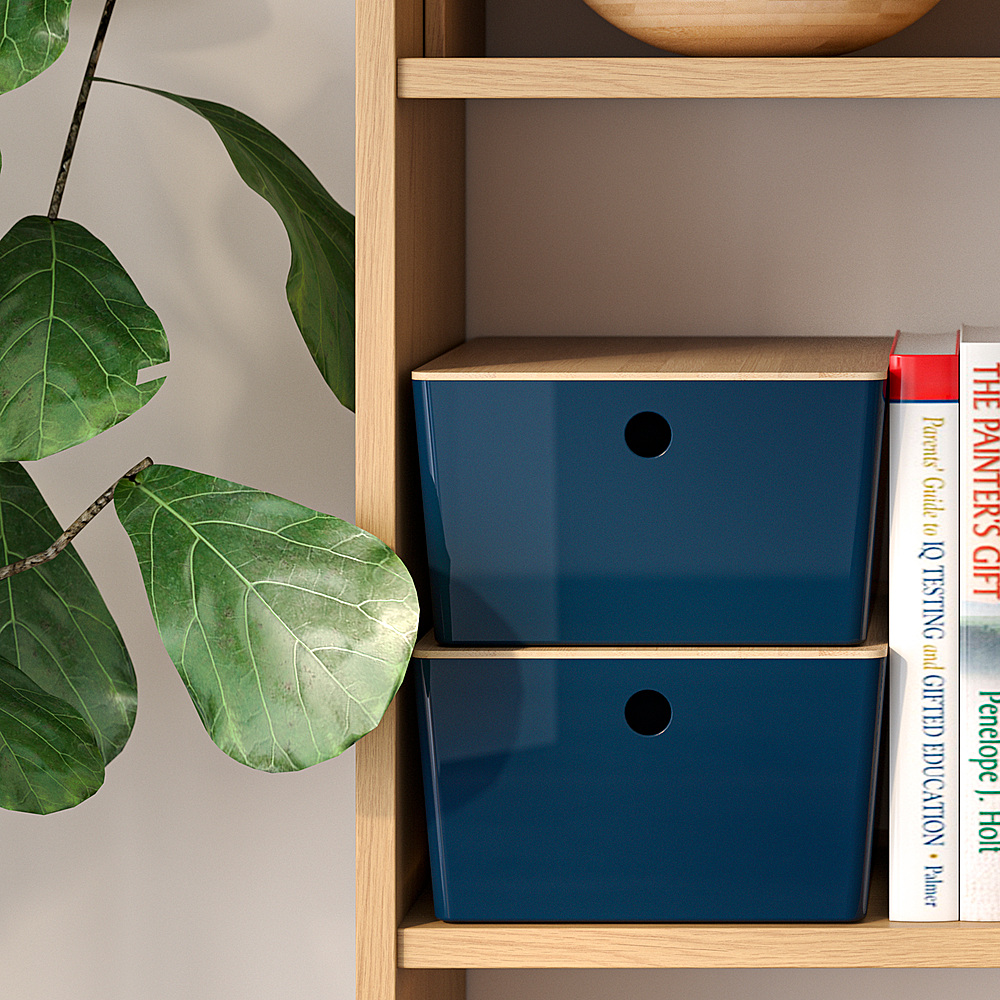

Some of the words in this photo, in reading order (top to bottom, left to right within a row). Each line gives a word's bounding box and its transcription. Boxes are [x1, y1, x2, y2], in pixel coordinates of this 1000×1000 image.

[920, 416, 946, 473] Parents'
[920, 476, 946, 518] Guide
[918, 541, 946, 561] IQ
[923, 523, 944, 537] to
[920, 565, 946, 640] TESTING
[920, 644, 946, 670] and
[920, 674, 946, 737] GIFTED
[920, 742, 946, 847] EDUCATION
[925, 865, 946, 908] Palmer
